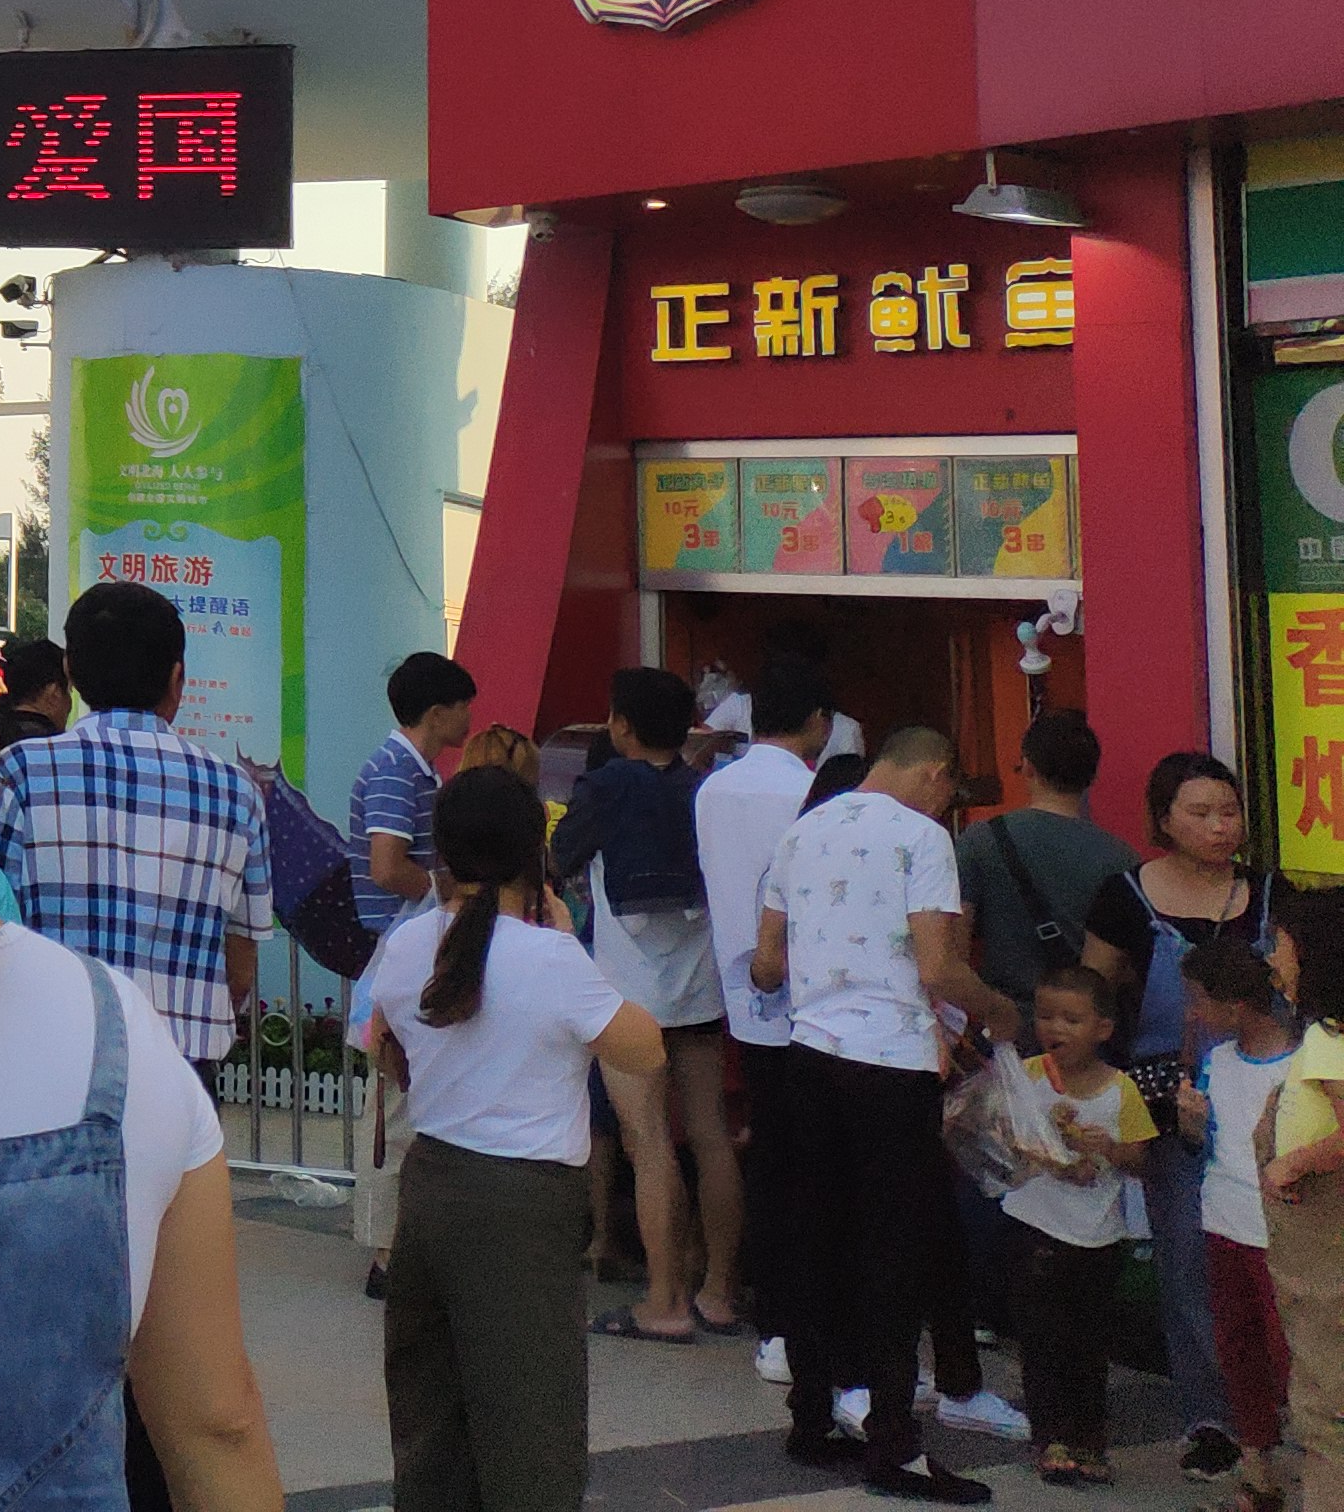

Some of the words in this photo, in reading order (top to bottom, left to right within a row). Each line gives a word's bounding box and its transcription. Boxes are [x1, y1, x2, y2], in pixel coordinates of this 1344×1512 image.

[5, 92, 242, 200] 爱国
[650, 258, 1074, 363] 正新鱿鱼
[98, 552, 214, 586] 文明旅游
